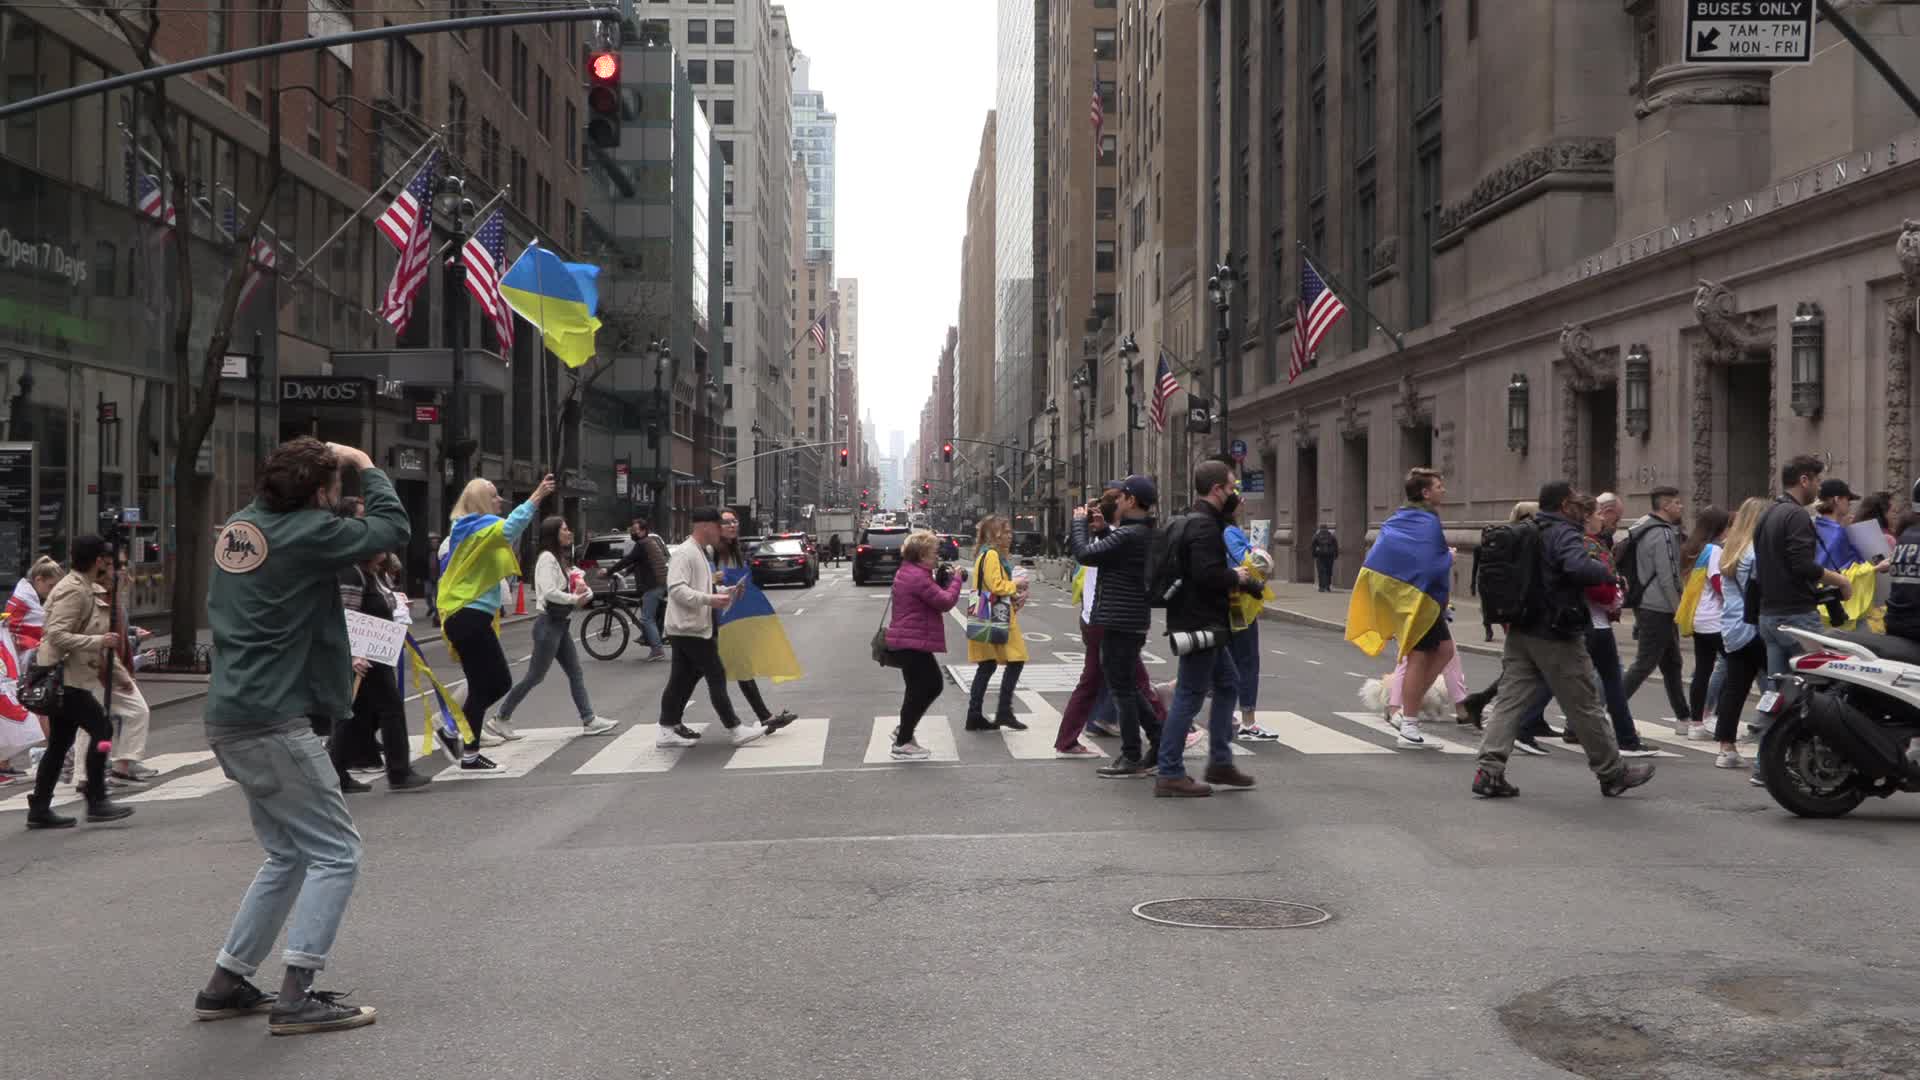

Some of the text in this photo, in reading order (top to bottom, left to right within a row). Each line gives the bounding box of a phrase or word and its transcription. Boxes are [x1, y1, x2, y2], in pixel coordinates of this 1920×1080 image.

[1697, 2, 1802, 16] BUSES ONLY
[1728, 24, 1759, 37] 7AM
[1771, 24, 1801, 37] 7PM
[1729, 41, 1760, 53] MON
[1775, 41, 1798, 53] FRI
[0, 228, 88, 287] Open 7 Days
[367, 641, 397, 657] DEAD
